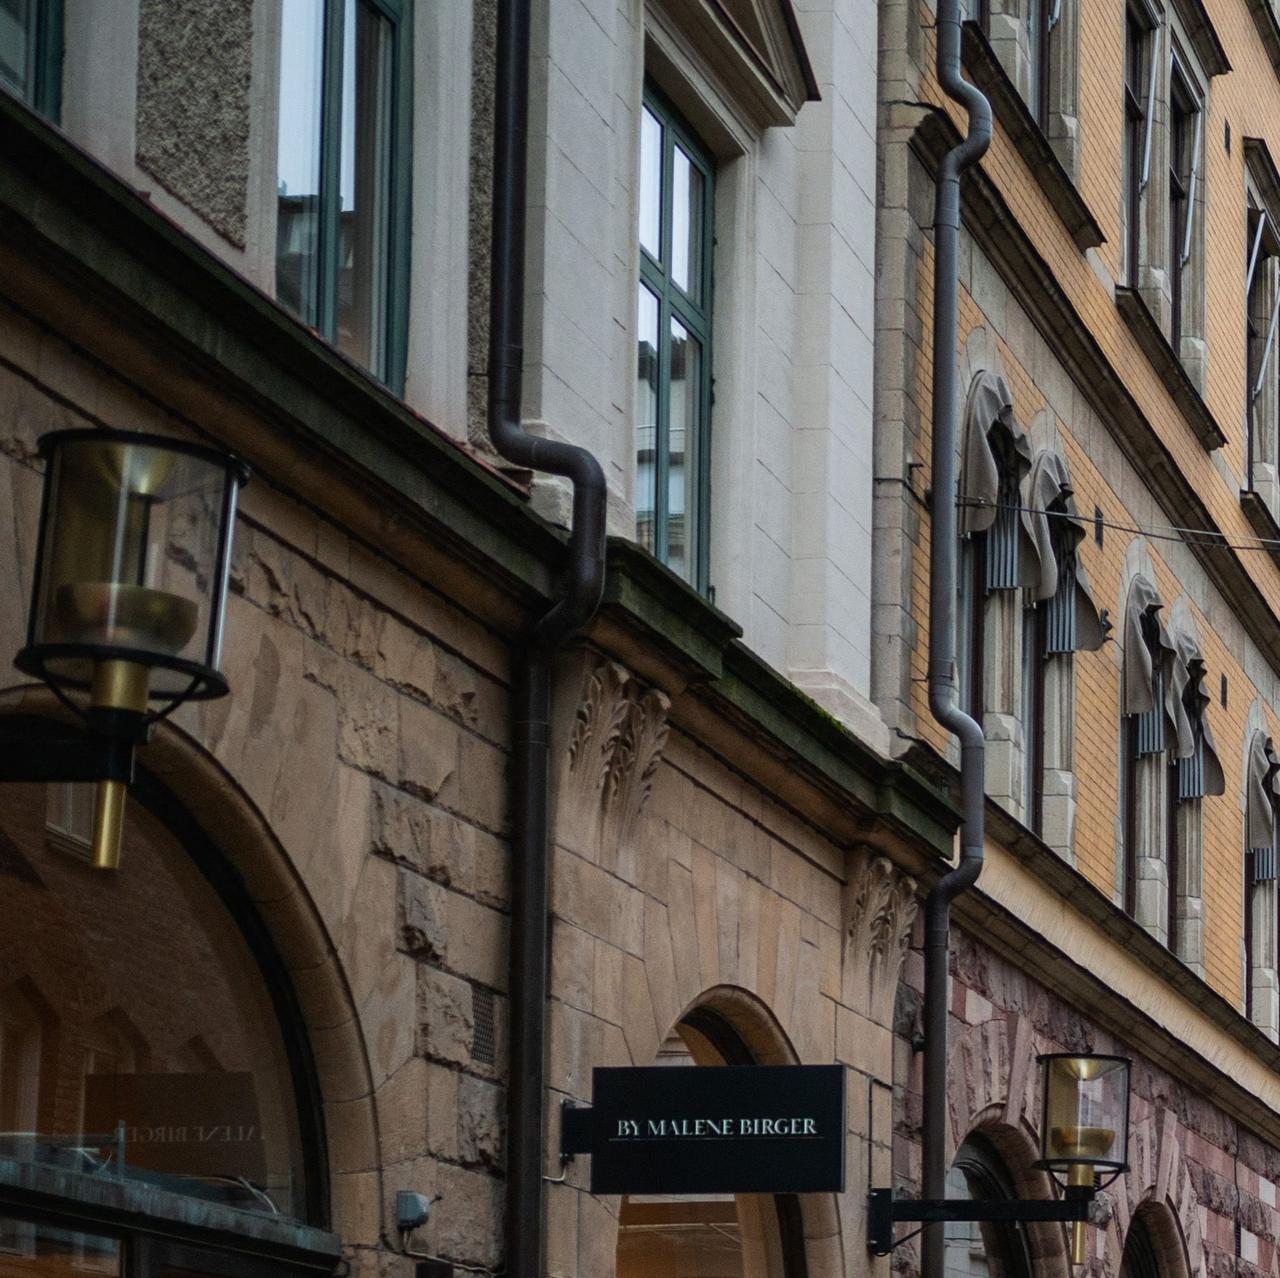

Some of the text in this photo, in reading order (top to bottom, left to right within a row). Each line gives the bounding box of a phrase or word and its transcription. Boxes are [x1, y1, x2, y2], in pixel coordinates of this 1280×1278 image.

[617, 1118, 817, 1136] BY MALENE BIRGER
